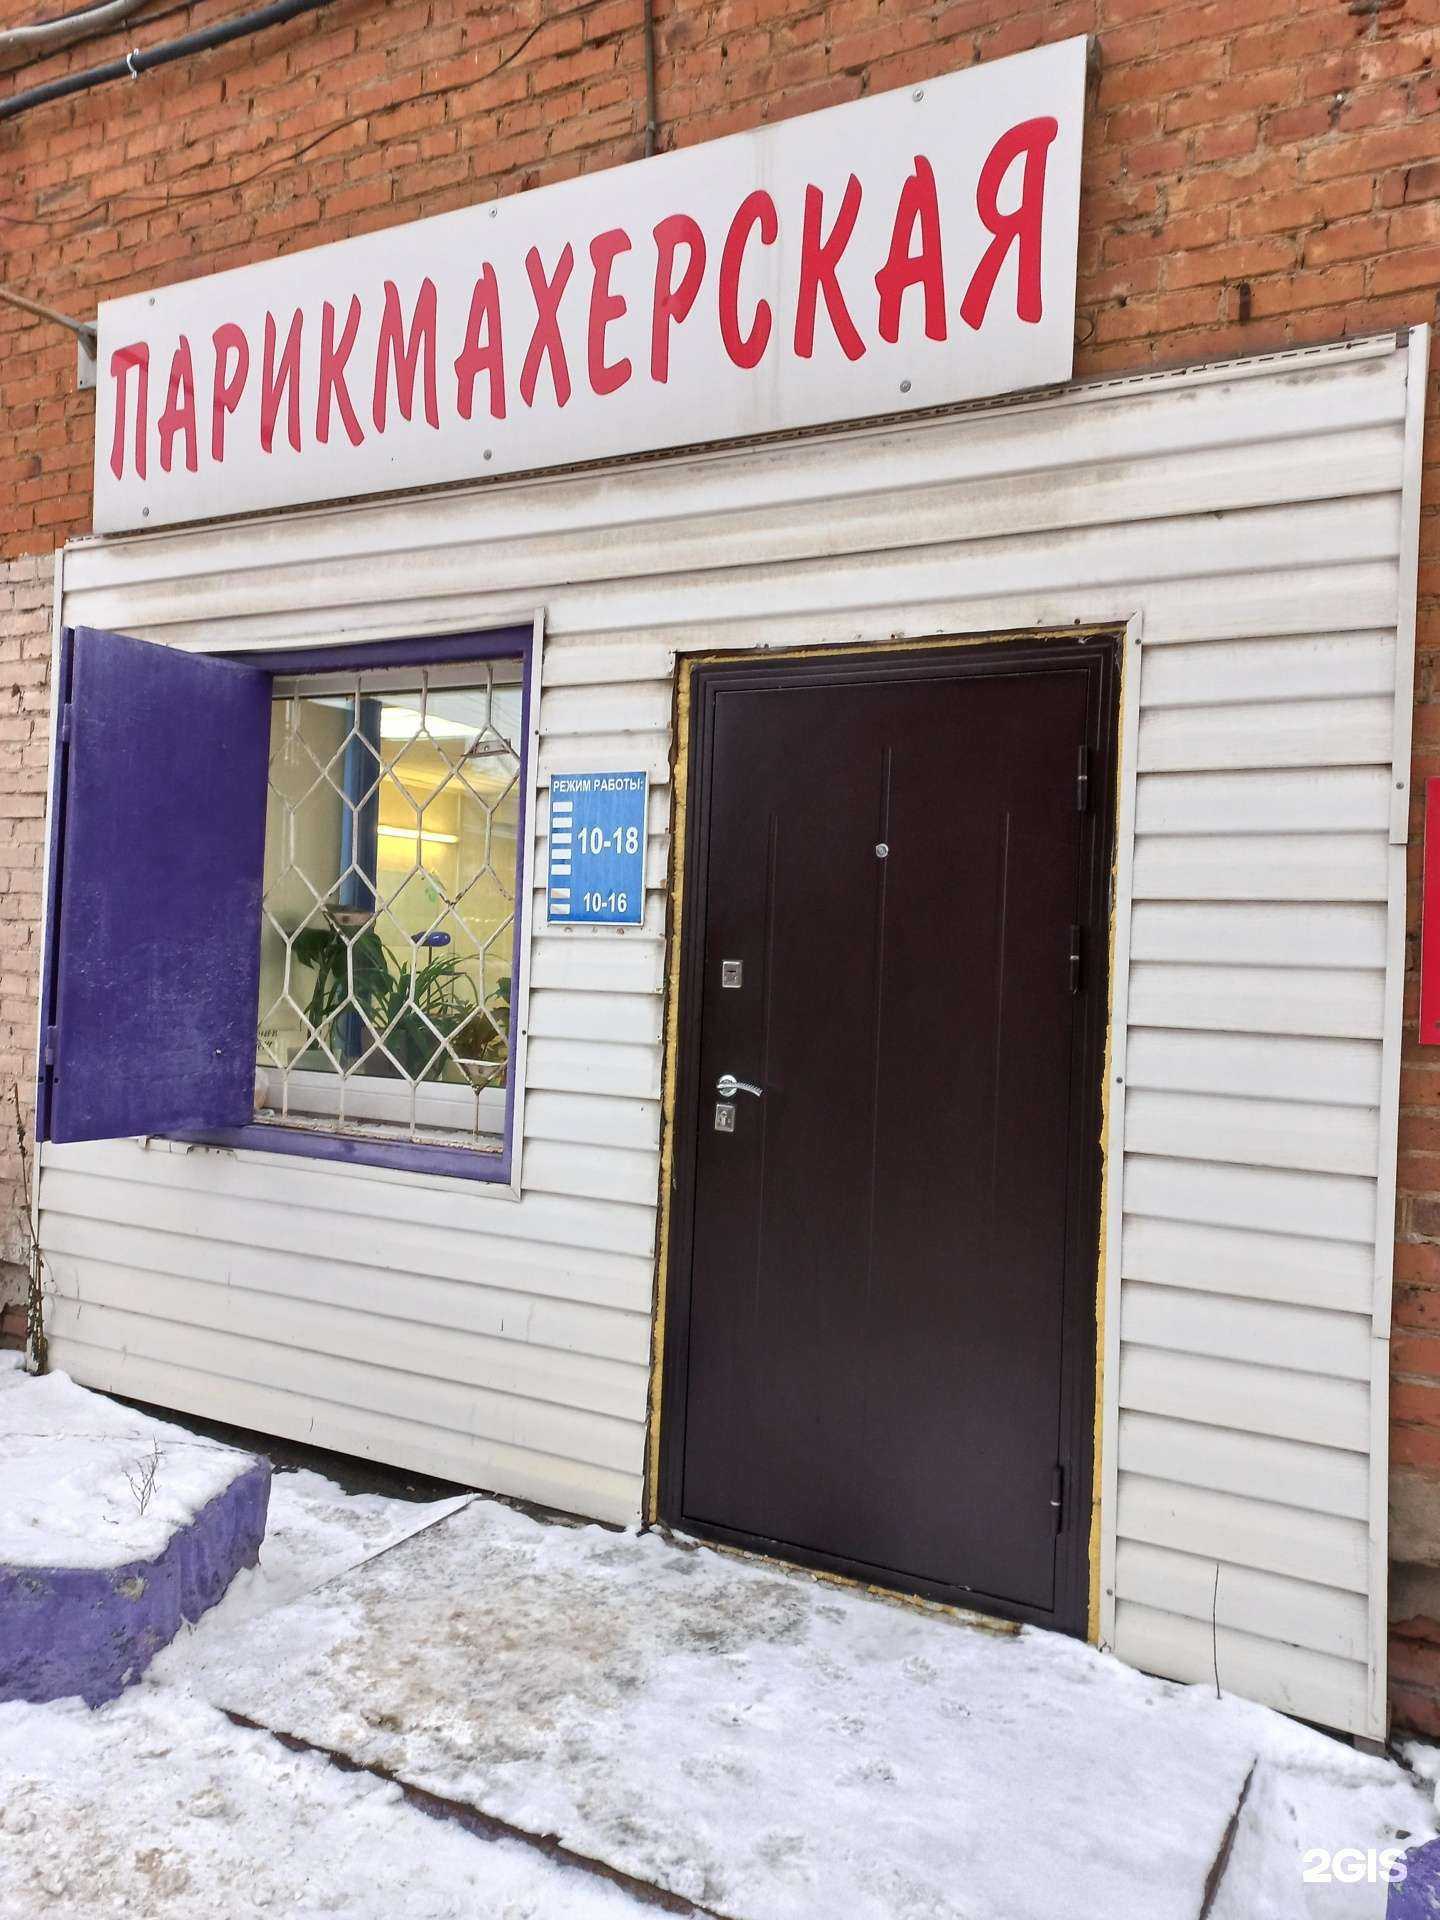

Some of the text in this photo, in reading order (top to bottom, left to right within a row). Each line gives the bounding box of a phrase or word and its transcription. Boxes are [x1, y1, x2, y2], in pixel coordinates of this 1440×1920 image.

[110, 116, 1059, 480] ПАРИКМАХЕРСКАЯ
[553, 777, 644, 792] РЕЖИМ РАБОТЫ:
[577, 826, 639, 854] 10-18
[583, 892, 628, 913] 10-16
